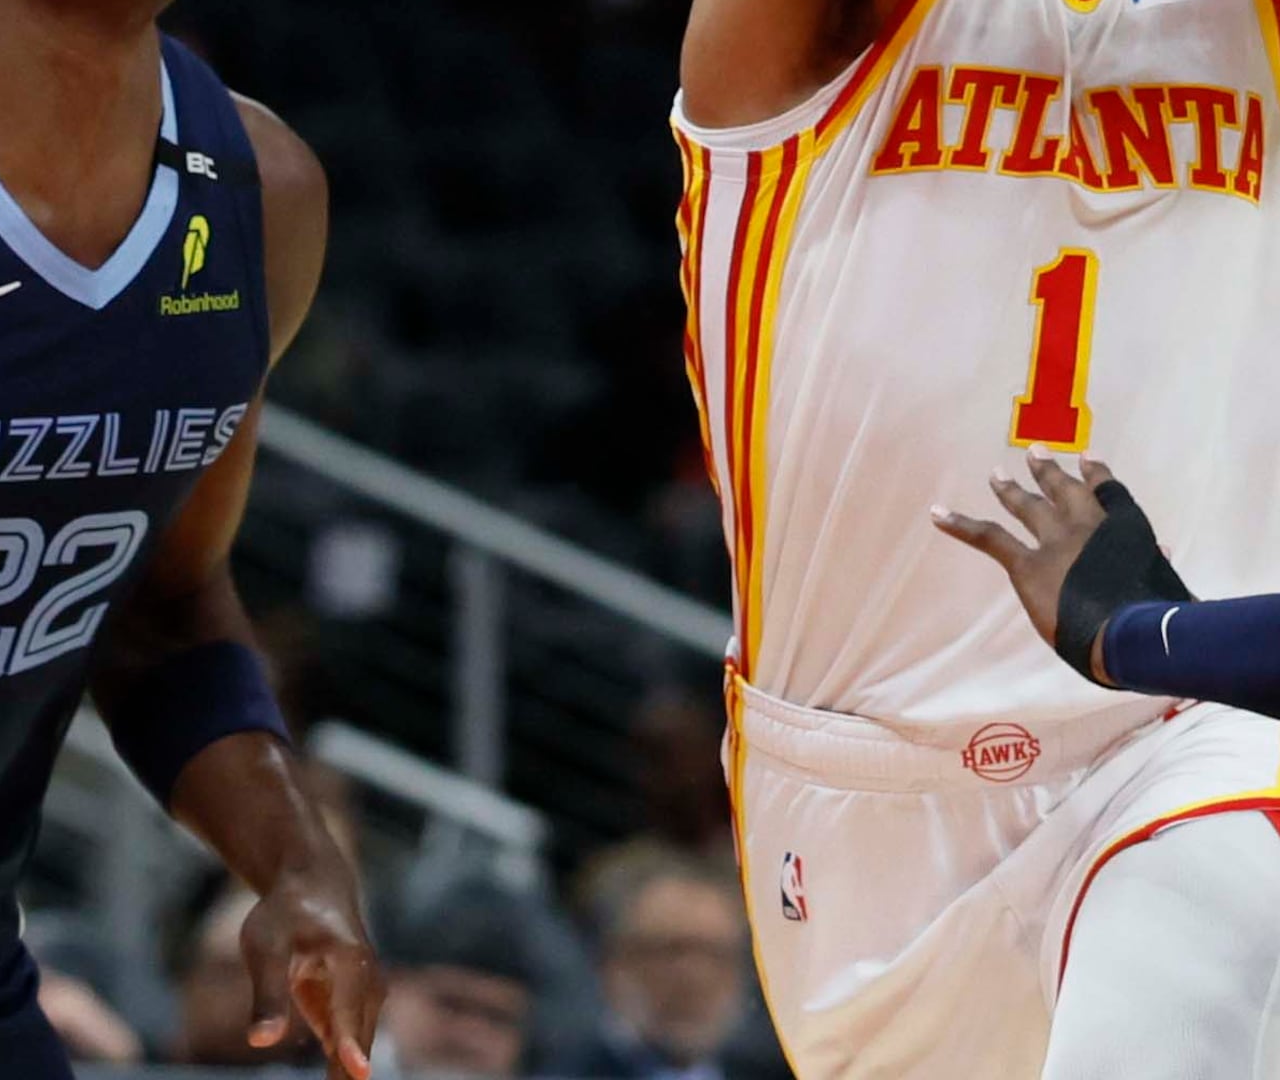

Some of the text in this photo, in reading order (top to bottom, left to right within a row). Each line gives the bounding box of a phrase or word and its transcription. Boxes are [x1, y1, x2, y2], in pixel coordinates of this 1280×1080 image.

[868, 64, 1265, 207] ATLANTA
[160, 290, 239, 316] Robinhood
[1008, 245, 1100, 453] 1
[961, 738, 1041, 769] HAWKS
